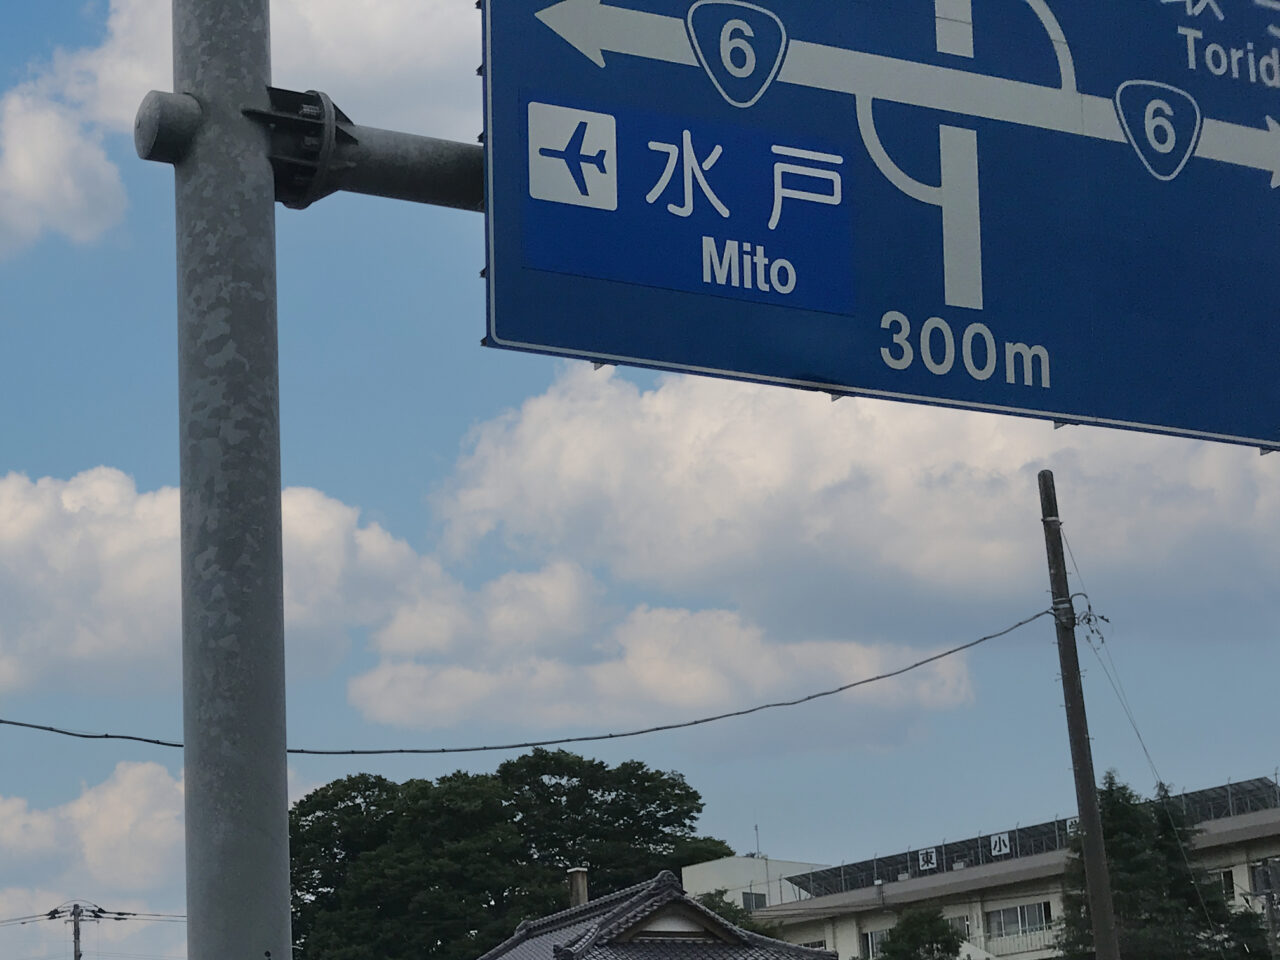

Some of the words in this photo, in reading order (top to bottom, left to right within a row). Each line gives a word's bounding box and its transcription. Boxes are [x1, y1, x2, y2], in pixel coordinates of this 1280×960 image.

[719, 18, 757, 79] 6
[1144, 98, 1176, 155] 6
[645, 130, 844, 229] 水戸
[701, 236, 797, 295] Mito
[879, 310, 1051, 389] 300m
